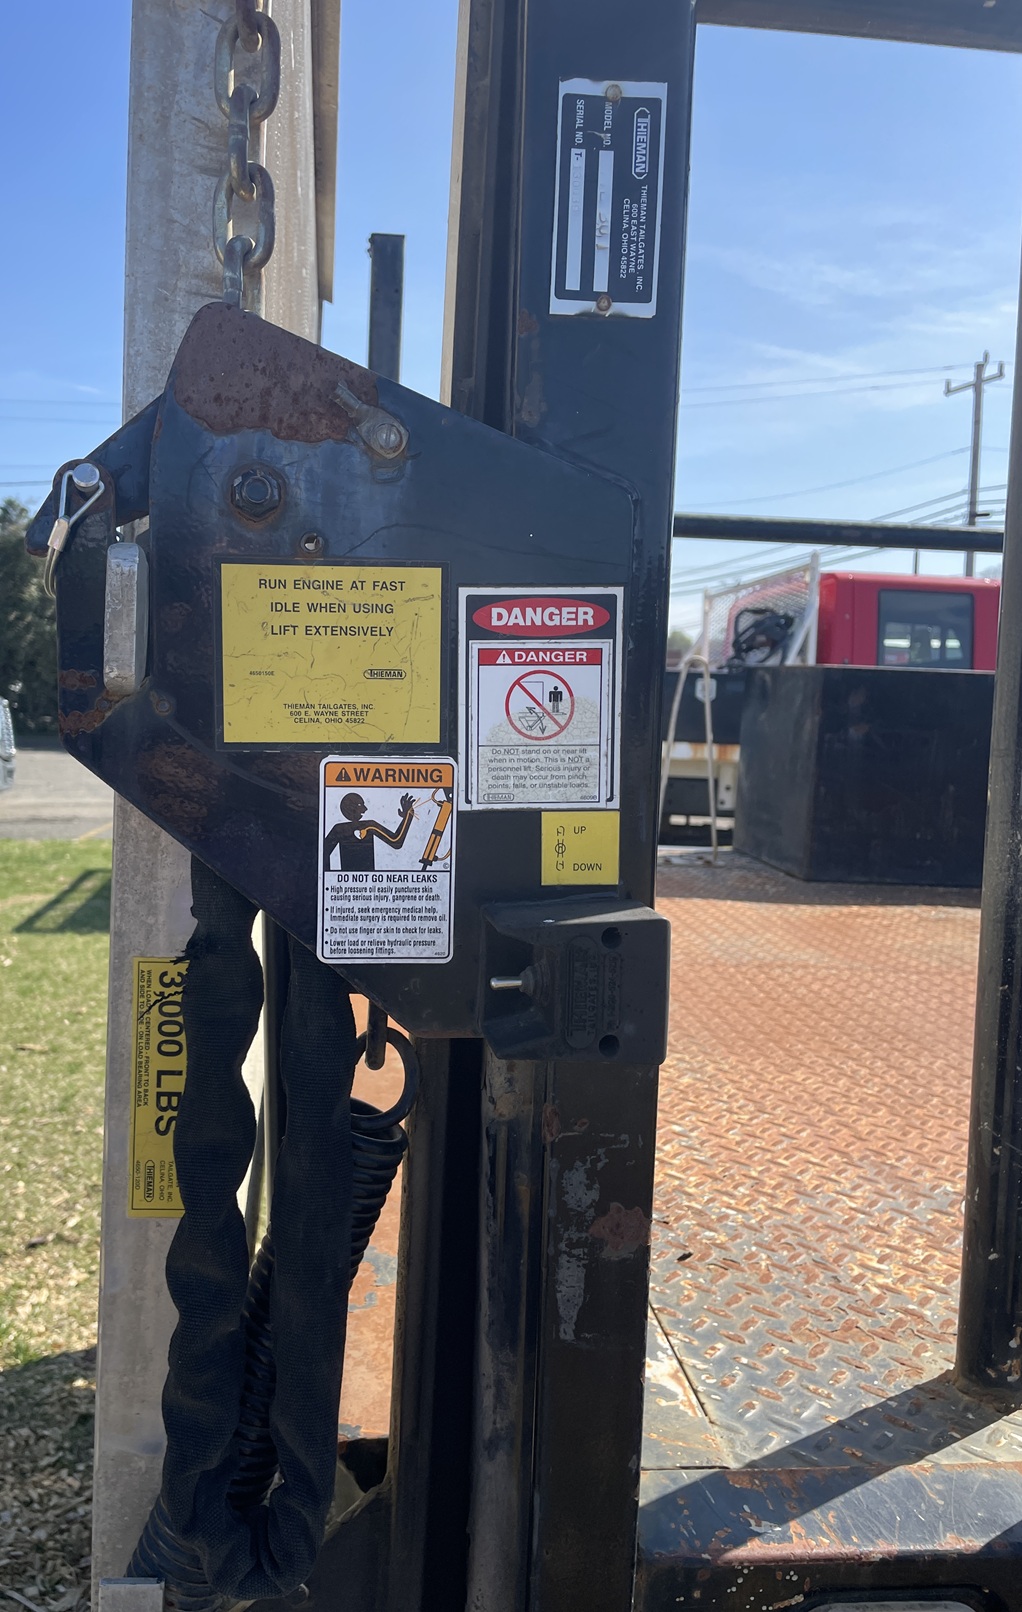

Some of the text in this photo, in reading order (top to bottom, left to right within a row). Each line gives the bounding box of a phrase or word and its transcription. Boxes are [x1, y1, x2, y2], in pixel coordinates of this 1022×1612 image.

[576, 99, 584, 129] SERIAL
[603, 102, 612, 147] MODEL NO.
[575, 132, 583, 145] NO.
[635, 115, 650, 173] THIEMAN
[259, 579, 405, 591] RUN ENGINE AT FAST
[271, 602, 393, 613] IDLE WHEN USING
[491, 607, 594, 626] DANGER
[271, 625, 393, 636] LIFT EXTENSIVELY
[515, 652, 587, 662] DANGER
[367, 669, 403, 678] THIEMAN
[354, 769, 442, 783] WARNING
[573, 826, 586, 834] UP
[573, 863, 602, 871] DOWN
[331, 886, 342, 894] High
[377, 886, 393, 894] easily
[331, 894, 351, 902] causing
[360, 927, 375, 935] finger
[348, 947, 374, 955] loosening
[376, 947, 395, 955] fittings.
[140, 1001, 144, 1009] TO
[138, 1031, 143, 1039] ON
[154, 971, 185, 1136] 3,000 LBS
[146, 1164, 155, 1198] THIEMAN
